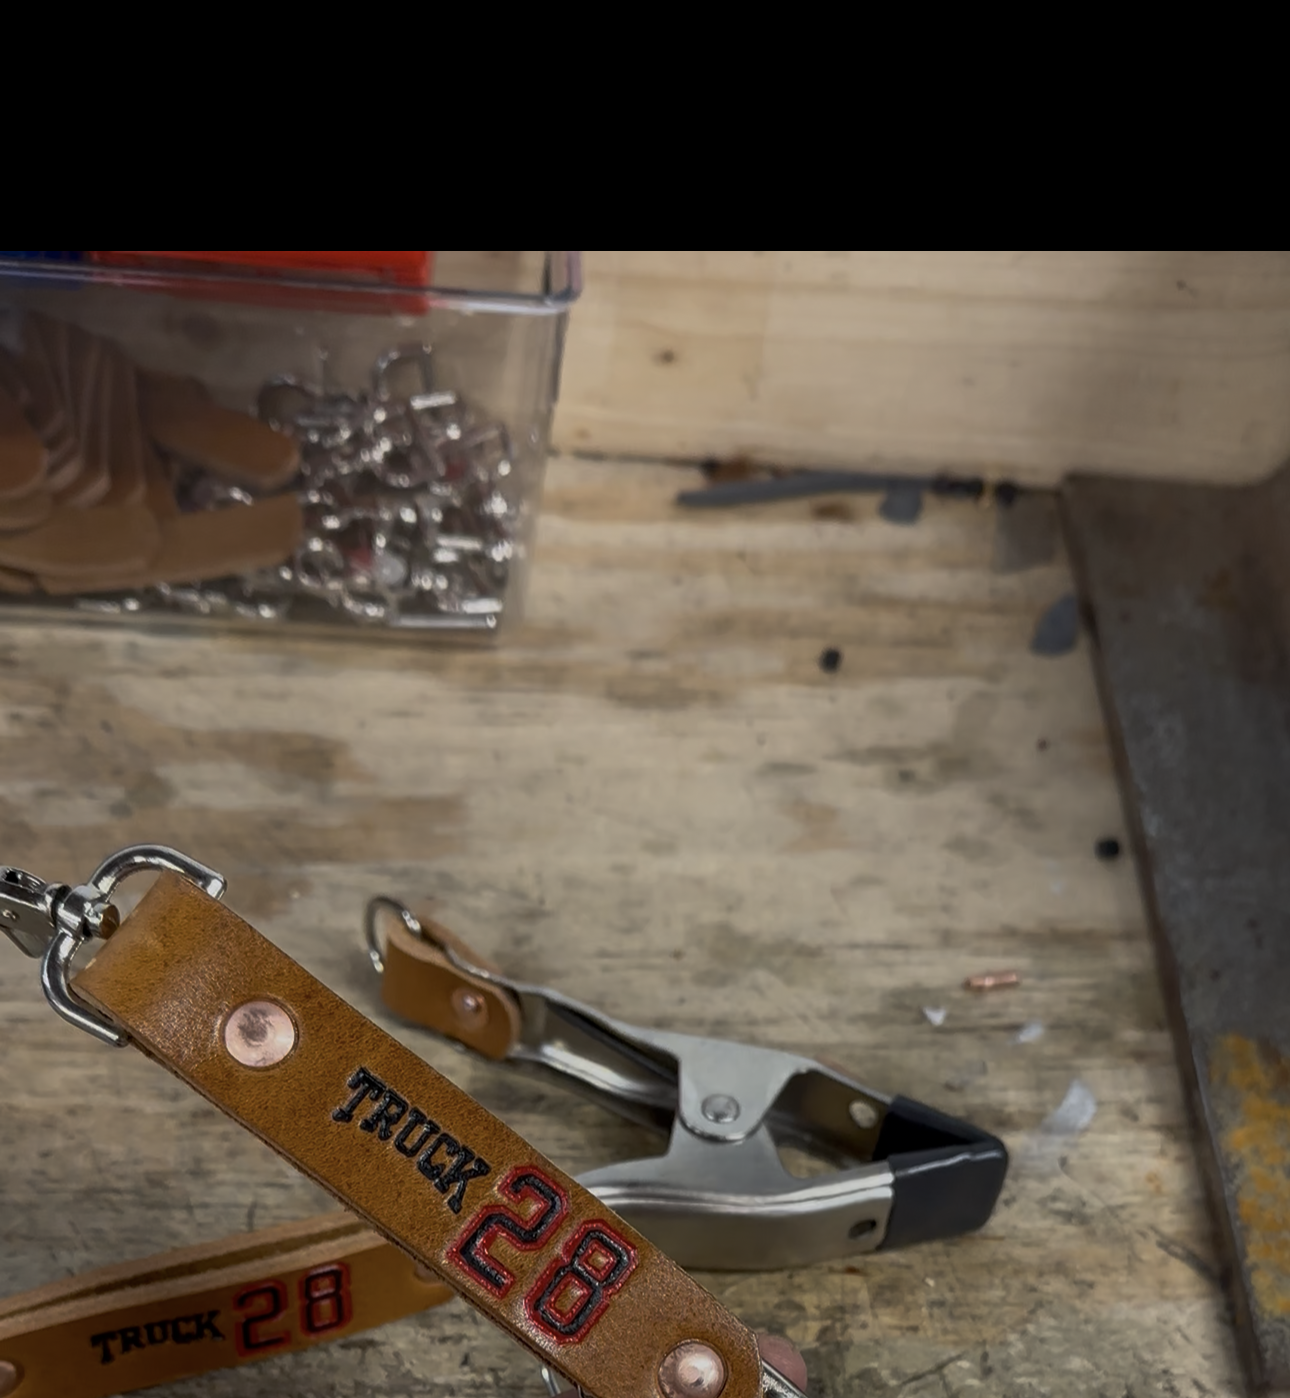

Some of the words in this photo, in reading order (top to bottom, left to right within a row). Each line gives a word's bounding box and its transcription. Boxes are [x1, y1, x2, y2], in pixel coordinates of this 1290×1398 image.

[333, 1068, 491, 1213] TRUCK
[447, 1165, 638, 1344] 28
[91, 1310, 226, 1365] TRUCK
[234, 1262, 352, 1356] 28
